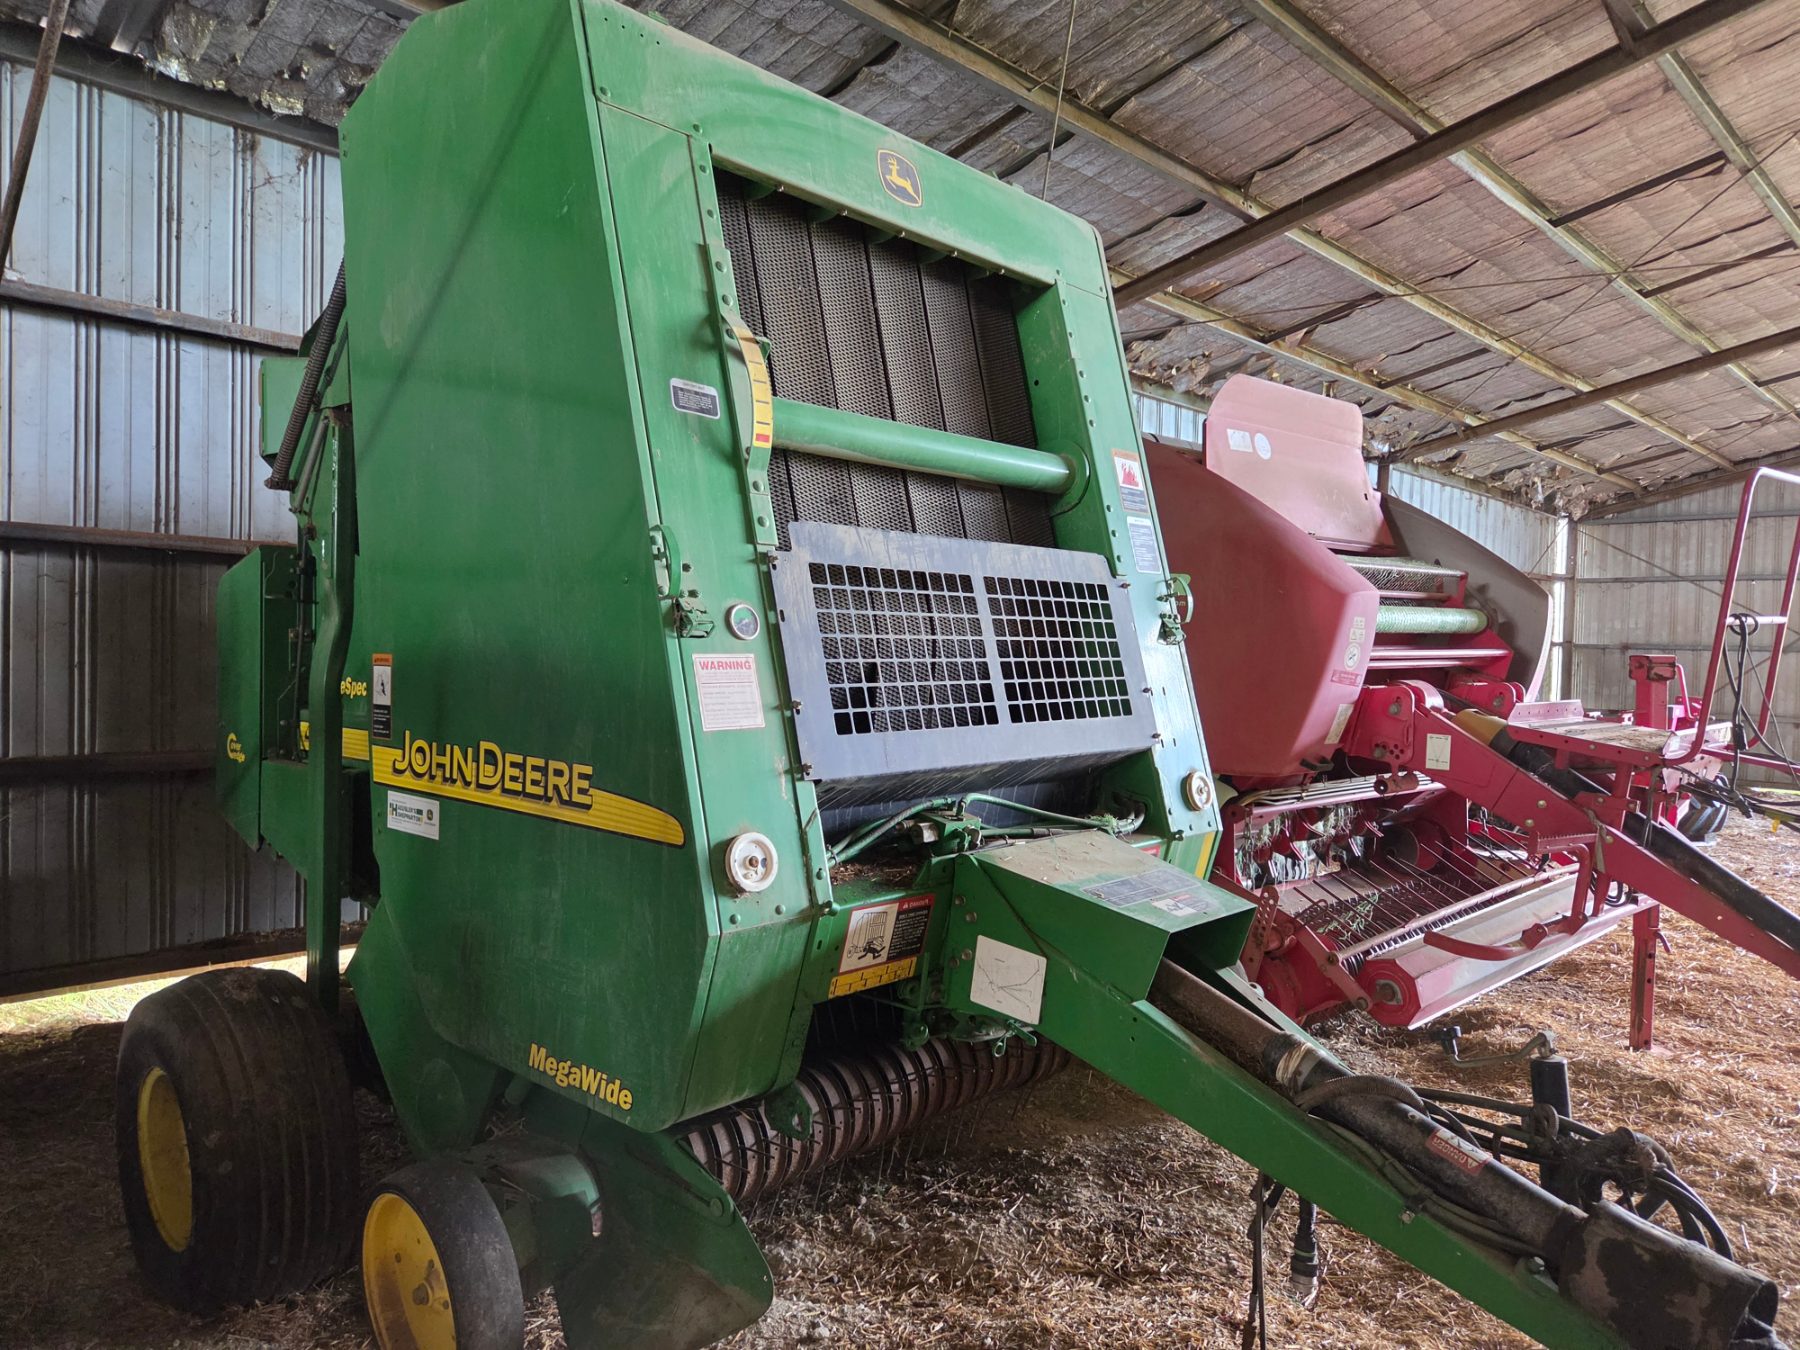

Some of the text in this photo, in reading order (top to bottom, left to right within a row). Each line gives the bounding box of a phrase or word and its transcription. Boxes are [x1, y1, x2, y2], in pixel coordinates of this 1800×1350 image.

[699, 660, 752, 671] WARNING
[394, 729, 593, 806] JOHN DEERE
[528, 1042, 634, 1112] MegaWide
